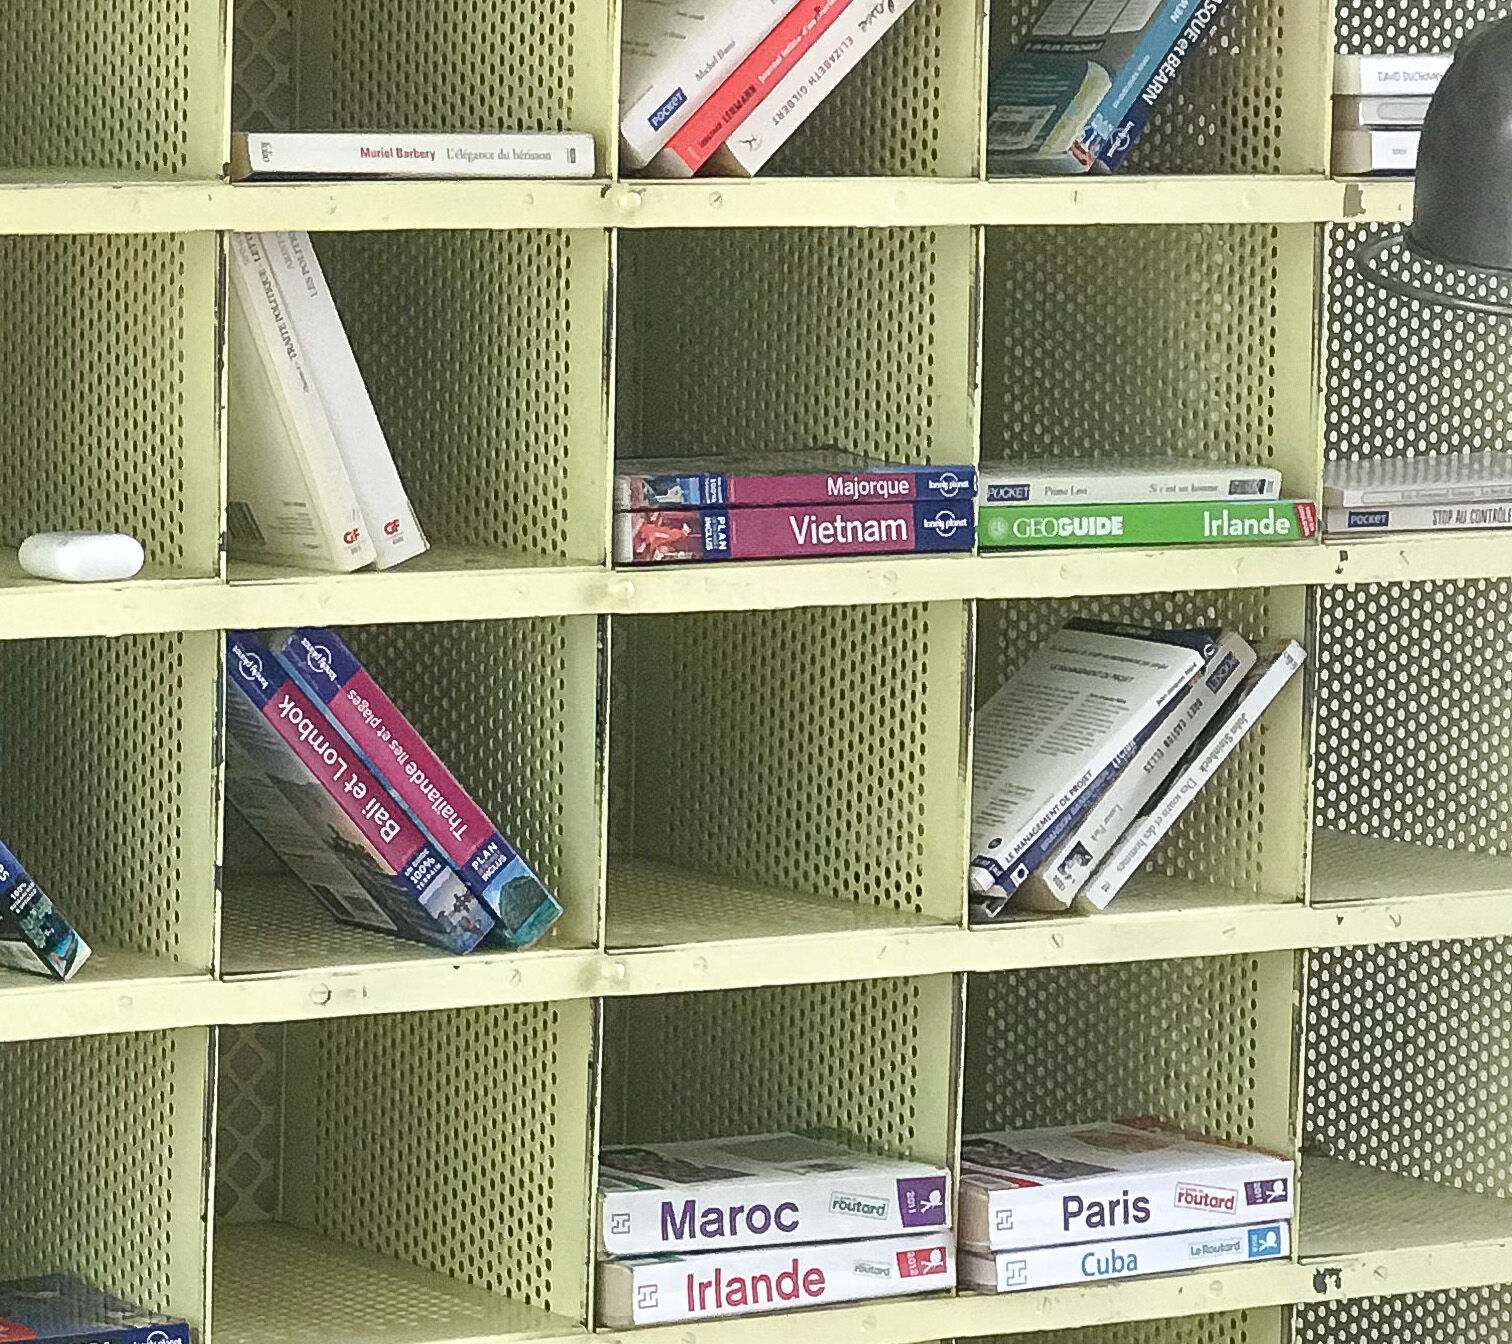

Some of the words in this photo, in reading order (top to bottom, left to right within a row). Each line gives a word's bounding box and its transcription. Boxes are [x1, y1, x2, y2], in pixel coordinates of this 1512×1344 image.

[1174, 38, 1189, 54] et
[806, 36, 854, 86] ELIZABETH
[1141, 52, 1183, 106] BÉARN
[769, 85, 809, 125] GILBERT
[360, 146, 394, 160] Muriel
[395, 147, 436, 162] Barbery
[827, 476, 910, 499] Majorque
[928, 479, 947, 492] lonely
[988, 486, 1031, 501] POCKET
[788, 513, 908, 546] Vietnam
[923, 518, 943, 530] lonely
[1013, 516, 1124, 538] GEOGUIDE
[1203, 508, 1290, 537] Irlande
[1350, 513, 1388, 525] POCKET
[1432, 509, 1453, 526] STOP
[1455, 510, 1467, 525] AU
[717, 515, 728, 551] PLAN
[344, 687, 382, 729] plages
[376, 726, 392, 742] et
[1228, 713, 1249, 736] John
[278, 694, 348, 781] Lombok
[1198, 733, 1233, 774] Steinbeck
[343, 776, 367, 800] et
[1179, 777, 1196, 796] Des
[405, 761, 470, 841] Thaïlande
[359, 799, 400, 842] Bali
[1005, 852, 1015, 862] LE
[1014, 803, 1061, 854] MANAGEMENT
[1059, 794, 1070, 806] DE
[1068, 770, 1093, 796] PROJET
[1142, 825, 1158, 841] des
[469, 842, 499, 869] PLAN
[480, 855, 508, 880] INCLUS
[1116, 838, 1147, 874] hommes
[10, 883, 27, 901] 100%
[832, 1197, 886, 1216] routard
[906, 1191, 916, 1215] 2011
[1062, 1190, 1151, 1232] Paris
[1177, 1190, 1236, 1211] routard
[660, 1199, 800, 1241] Maroc
[1202, 1240, 1241, 1255] Routard
[905, 1251, 917, 1276] 2012
[1080, 1249, 1138, 1277] Cuba
[687, 1258, 826, 1312] Irlande
